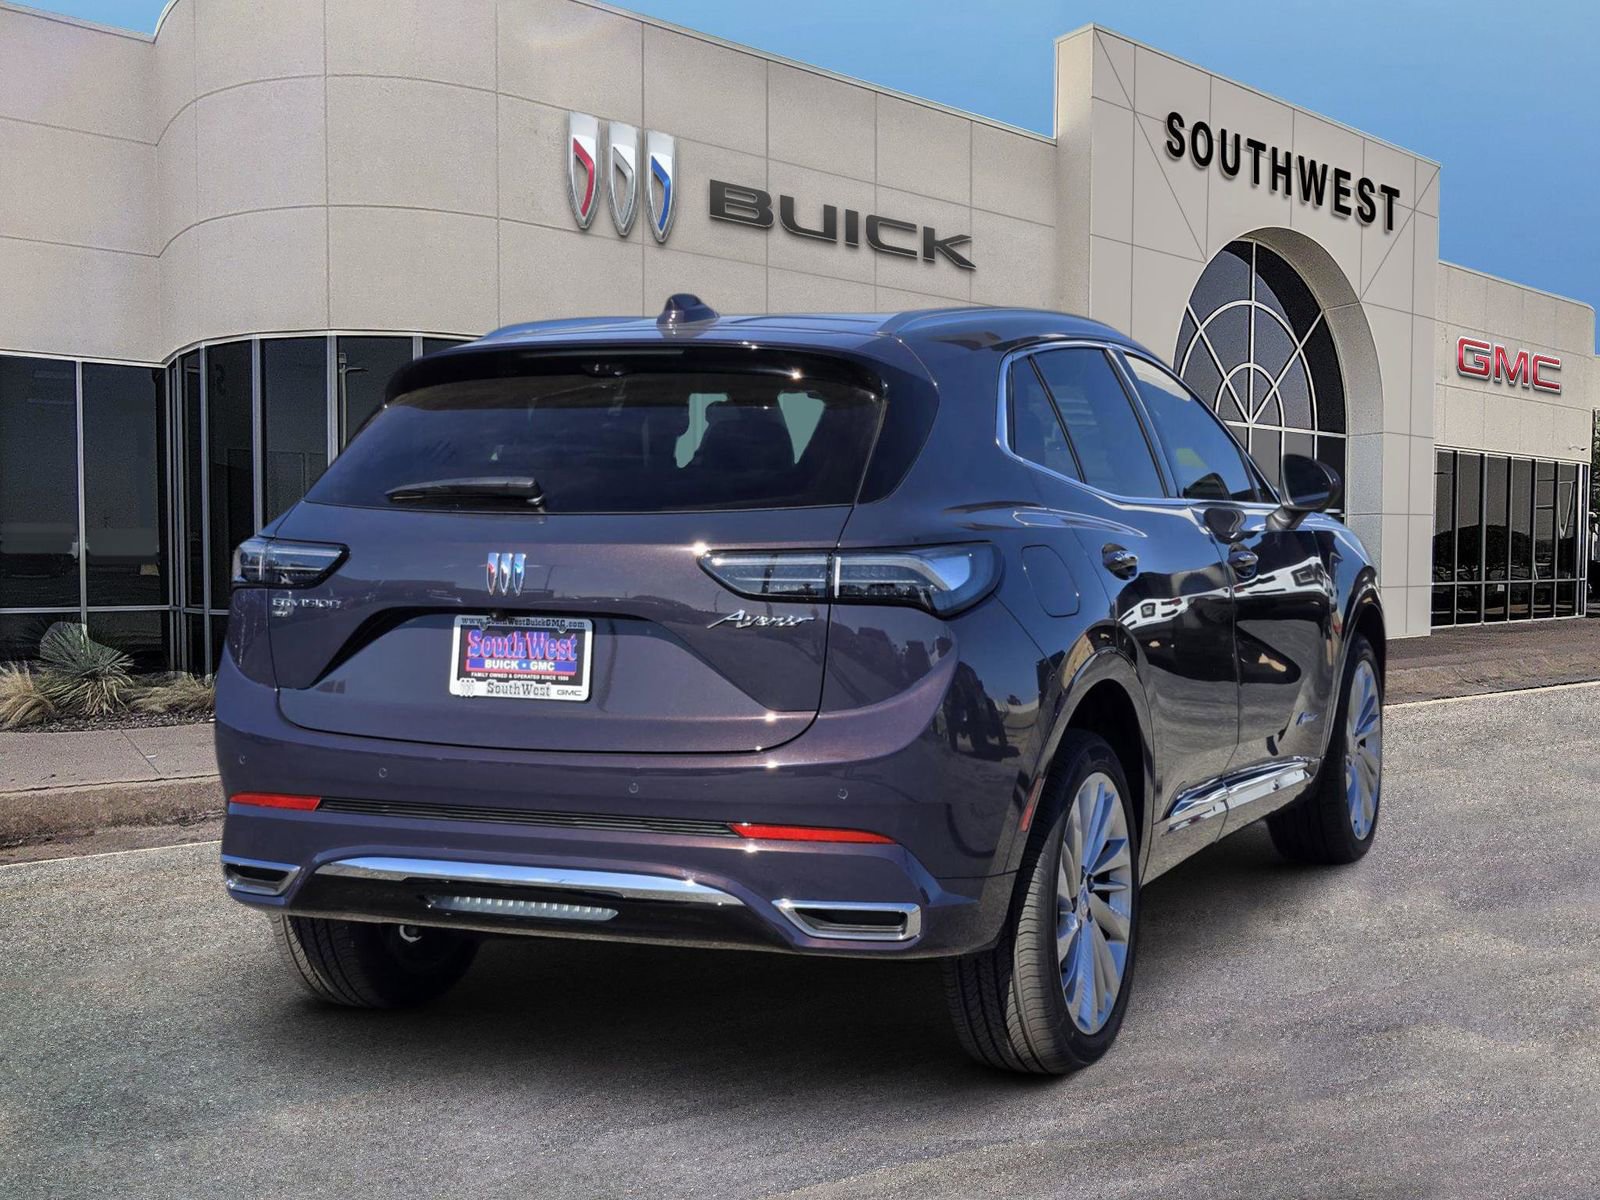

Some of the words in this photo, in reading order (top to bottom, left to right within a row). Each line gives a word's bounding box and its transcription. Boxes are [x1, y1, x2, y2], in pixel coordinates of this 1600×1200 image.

[1166, 111, 1400, 232] SOUTHWEST
[709, 179, 977, 270] BUICK
[1457, 336, 1562, 394] GMC
[707, 609, 815, 629] Avenir
[484, 659, 519, 669] BUICK
[530, 661, 556, 671] GMC
[557, 689, 583, 697] GMC
